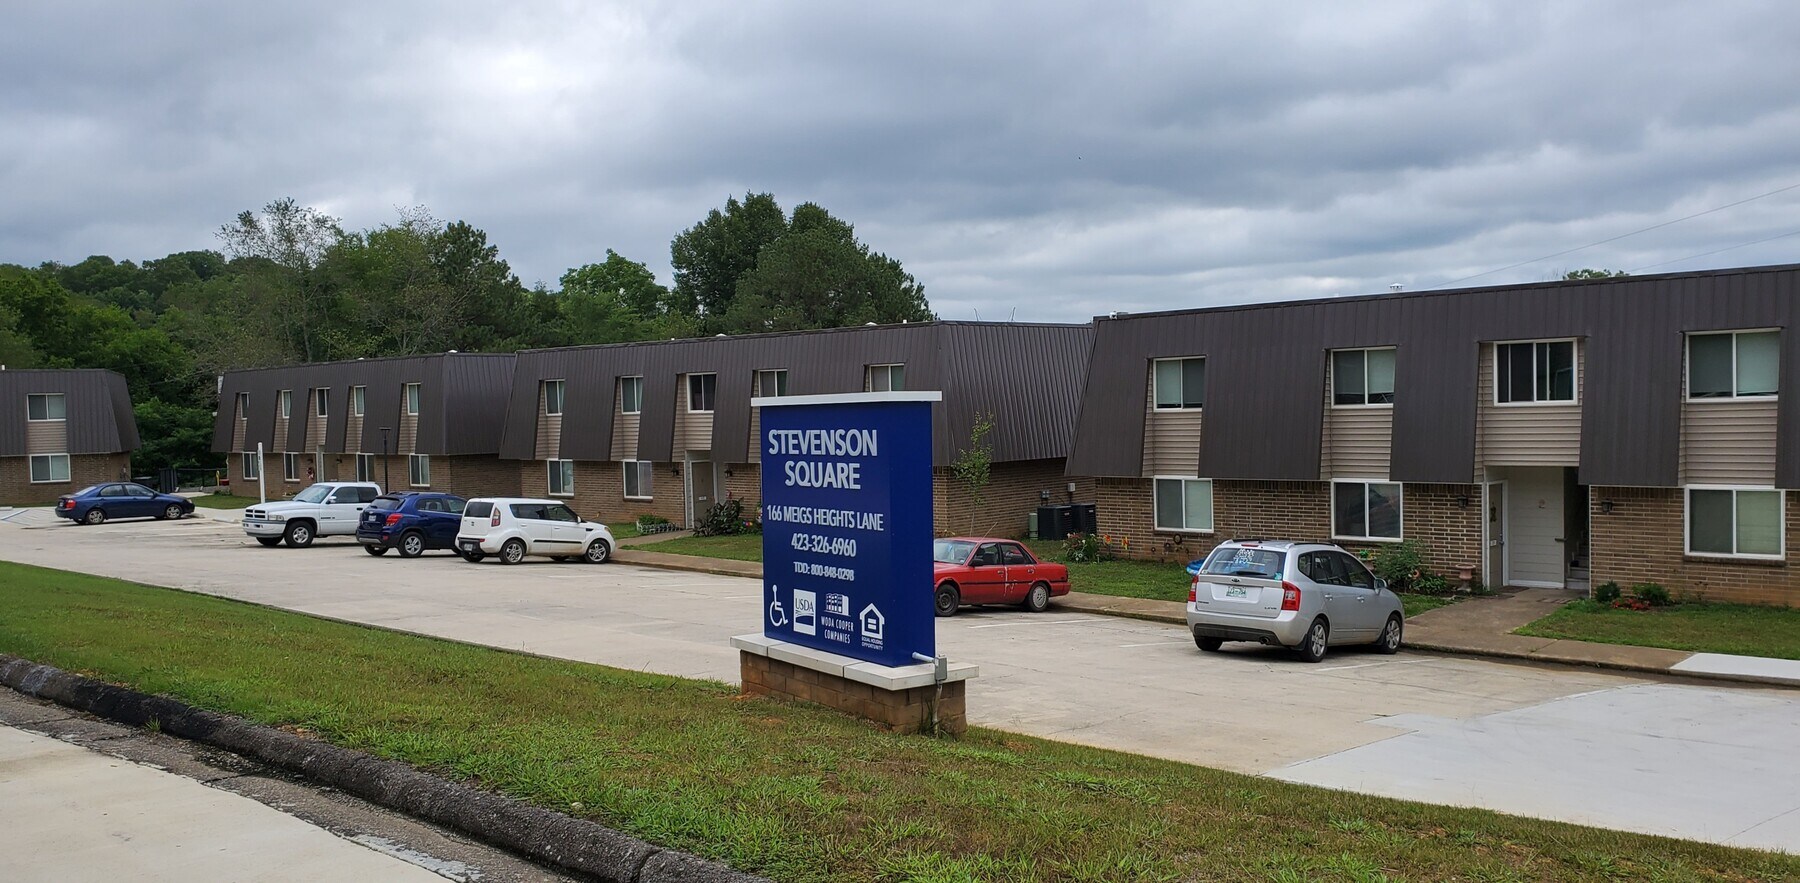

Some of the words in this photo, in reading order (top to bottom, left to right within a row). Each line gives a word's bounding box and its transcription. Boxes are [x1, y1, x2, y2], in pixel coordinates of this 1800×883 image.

[768, 429, 877, 456] STEVENSON
[785, 461, 861, 489] SQUARE
[767, 505, 782, 521] 166
[783, 506, 812, 524] MEIGS
[814, 508, 855, 528] HEIGHTS
[857, 512, 884, 531] LANE
[791, 533, 856, 557] 423-326-6960
[793, 561, 810, 574] TDD:
[795, 598, 814, 612] USDA
[821, 616, 834, 628] WODA
[835, 619, 854, 632] COOPER
[824, 629, 850, 644] COMPANIES
